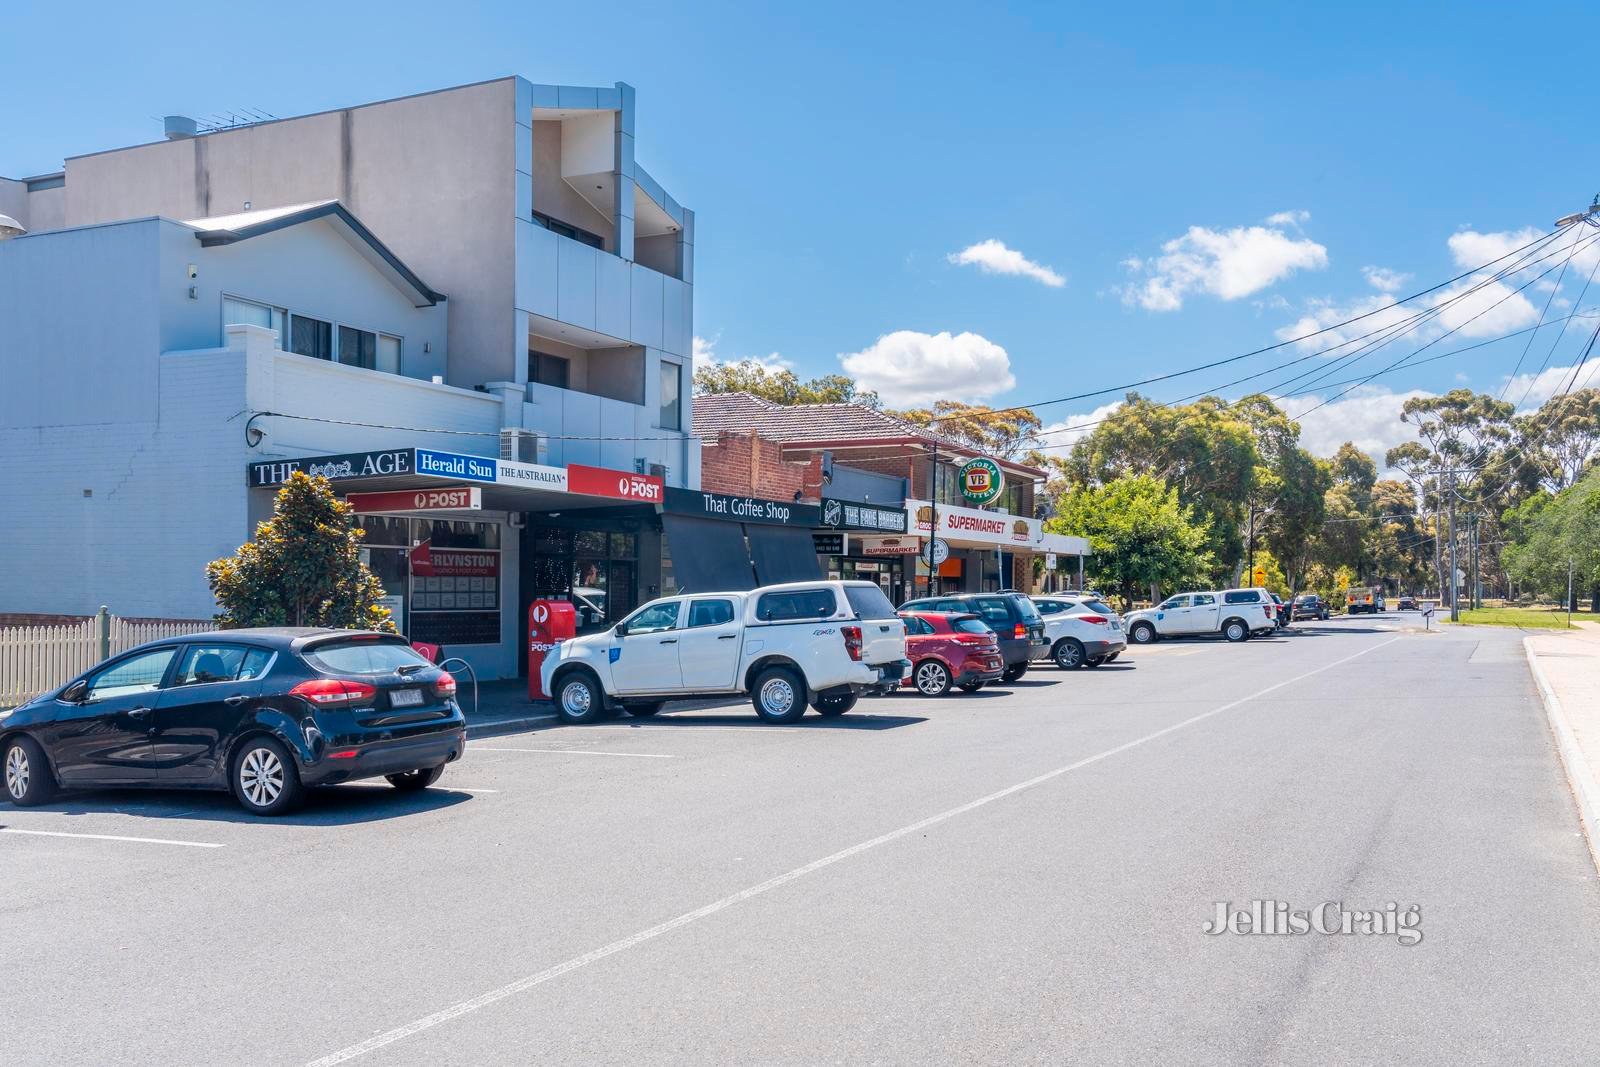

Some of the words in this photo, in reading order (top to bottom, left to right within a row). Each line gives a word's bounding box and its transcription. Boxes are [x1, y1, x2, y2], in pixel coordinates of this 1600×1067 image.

[360, 452, 409, 476] AGE
[421, 454, 465, 475] Herald
[469, 460, 493, 478] Sun
[961, 461, 998, 477] VICTORIA
[500, 467, 516, 478] THE
[516, 469, 562, 484] AUSTRALIAN
[970, 475, 984, 485] VB
[631, 481, 660, 499] POST
[963, 488, 995, 498] BITTER
[429, 492, 468, 507] POST
[703, 494, 727, 514] That
[731, 498, 763, 517] Coffee
[766, 502, 790, 523] Shop
[844, 505, 860, 526] THE
[947, 514, 1006, 534] SUPERMARKET
